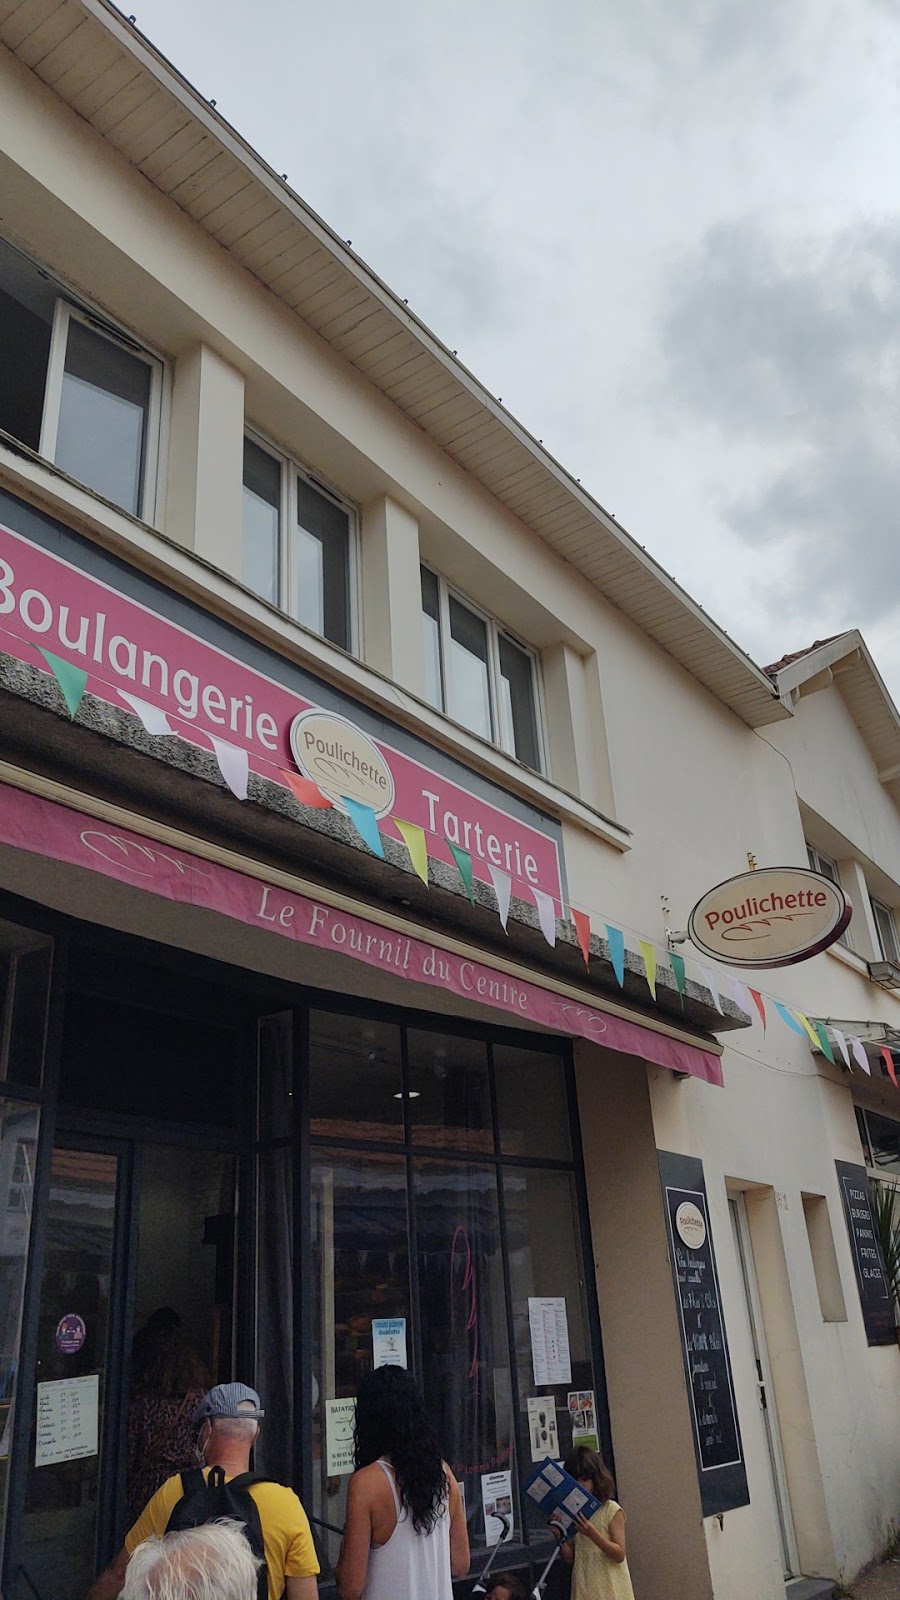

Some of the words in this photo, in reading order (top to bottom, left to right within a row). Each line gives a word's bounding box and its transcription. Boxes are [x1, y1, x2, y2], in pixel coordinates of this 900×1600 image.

[304, 731, 387, 790] Poulichette
[422, 789, 539, 884] Tarterie
[704, 890, 827, 930] Poulichette
[256, 886, 295, 927] Le
[308, 906, 411, 969] Fournil
[423, 949, 451, 982] du
[459, 962, 528, 1010] Centre
[330, 1405, 355, 1413] NATATIO
